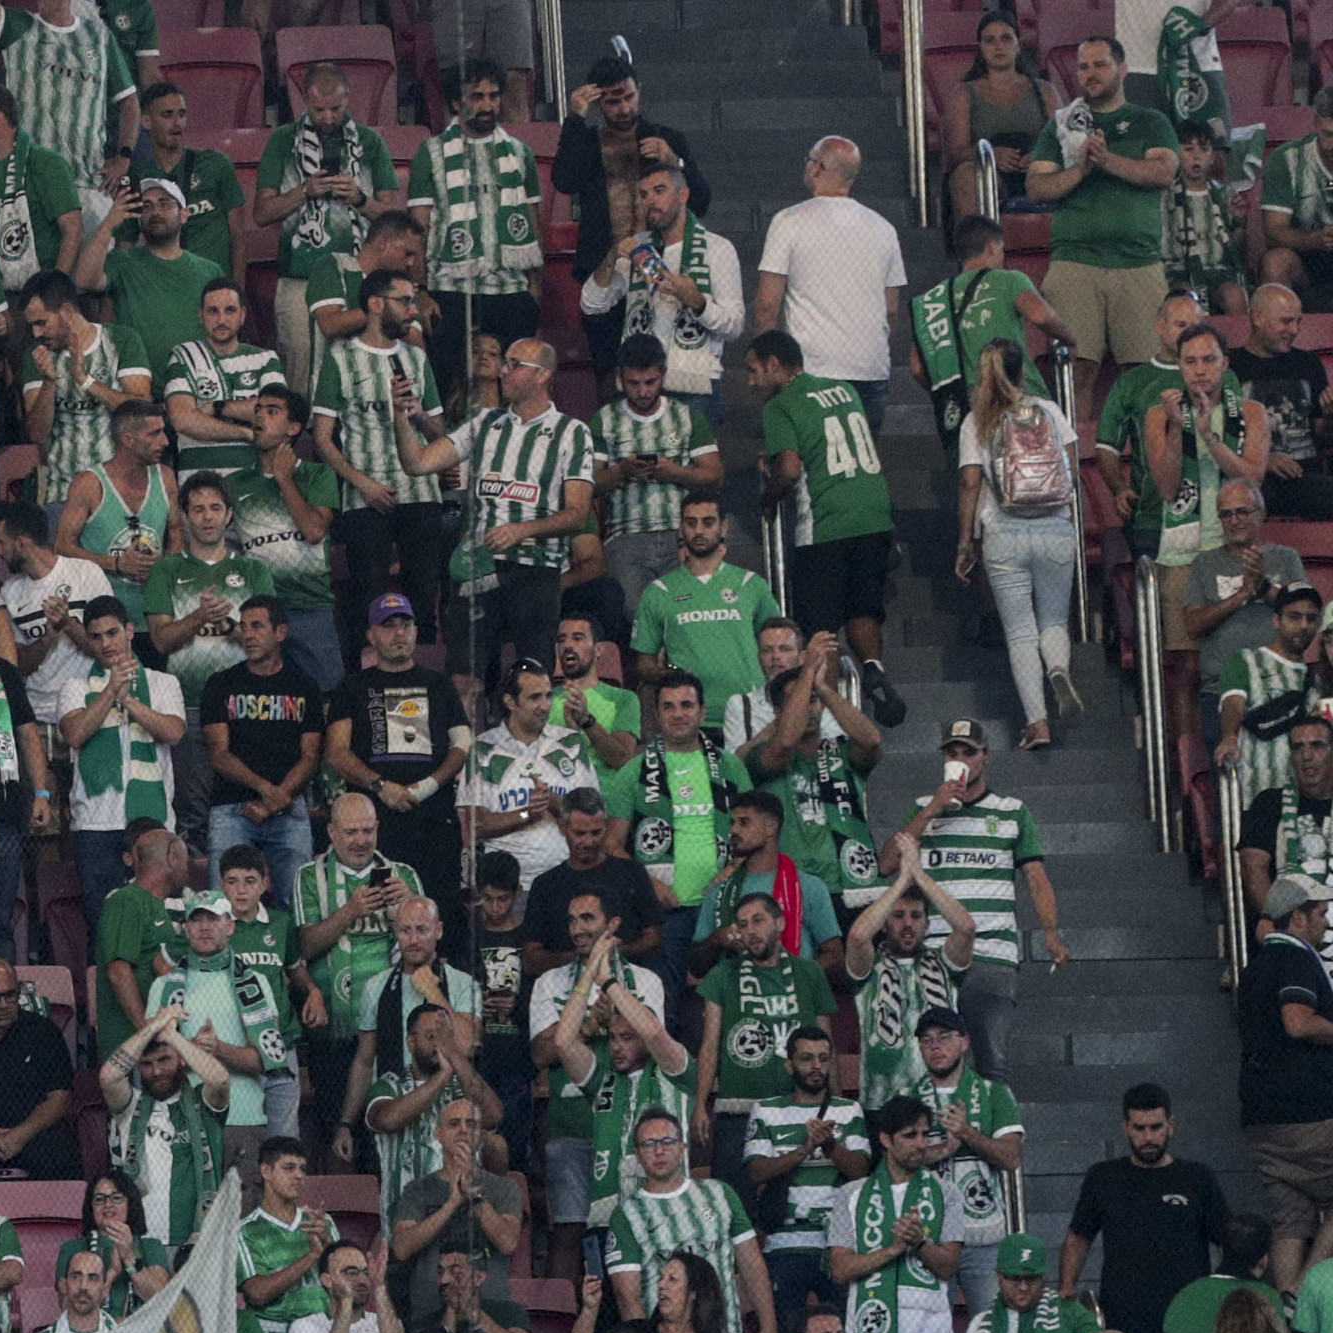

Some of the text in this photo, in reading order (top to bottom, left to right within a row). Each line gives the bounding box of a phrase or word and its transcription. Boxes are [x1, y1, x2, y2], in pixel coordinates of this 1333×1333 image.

[823, 413, 882, 480] 40
[676, 608, 742, 625] HONDA
[944, 850, 997, 867] BETANO
